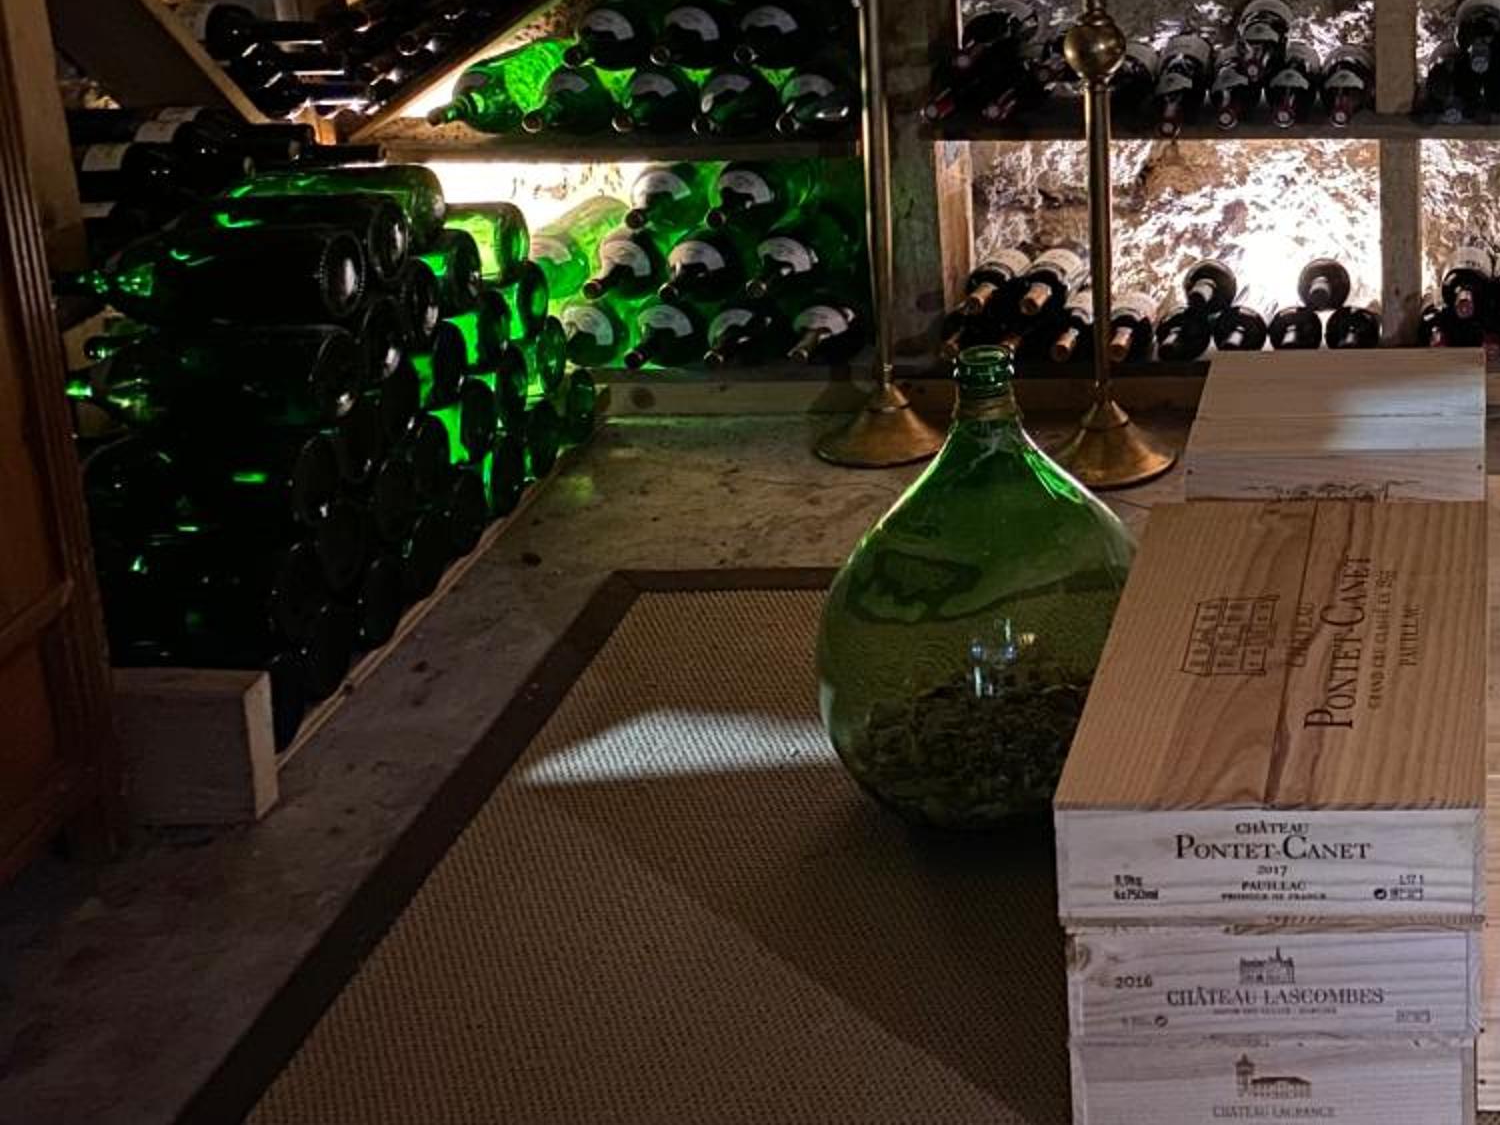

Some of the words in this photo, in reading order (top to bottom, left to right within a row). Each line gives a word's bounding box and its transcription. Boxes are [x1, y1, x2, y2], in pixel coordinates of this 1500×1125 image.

[1235, 820, 1309, 834] CHÂTEAU
[1175, 833, 1372, 860] PONTET-CANET
[1257, 865, 1288, 877] 2017
[1241, 880, 1307, 891] PAUILLAC
[1115, 975, 1152, 989] 2016
[1167, 986, 1257, 1006] CHÂTEAU
[1263, 987, 1385, 1005] LASCOMBES
